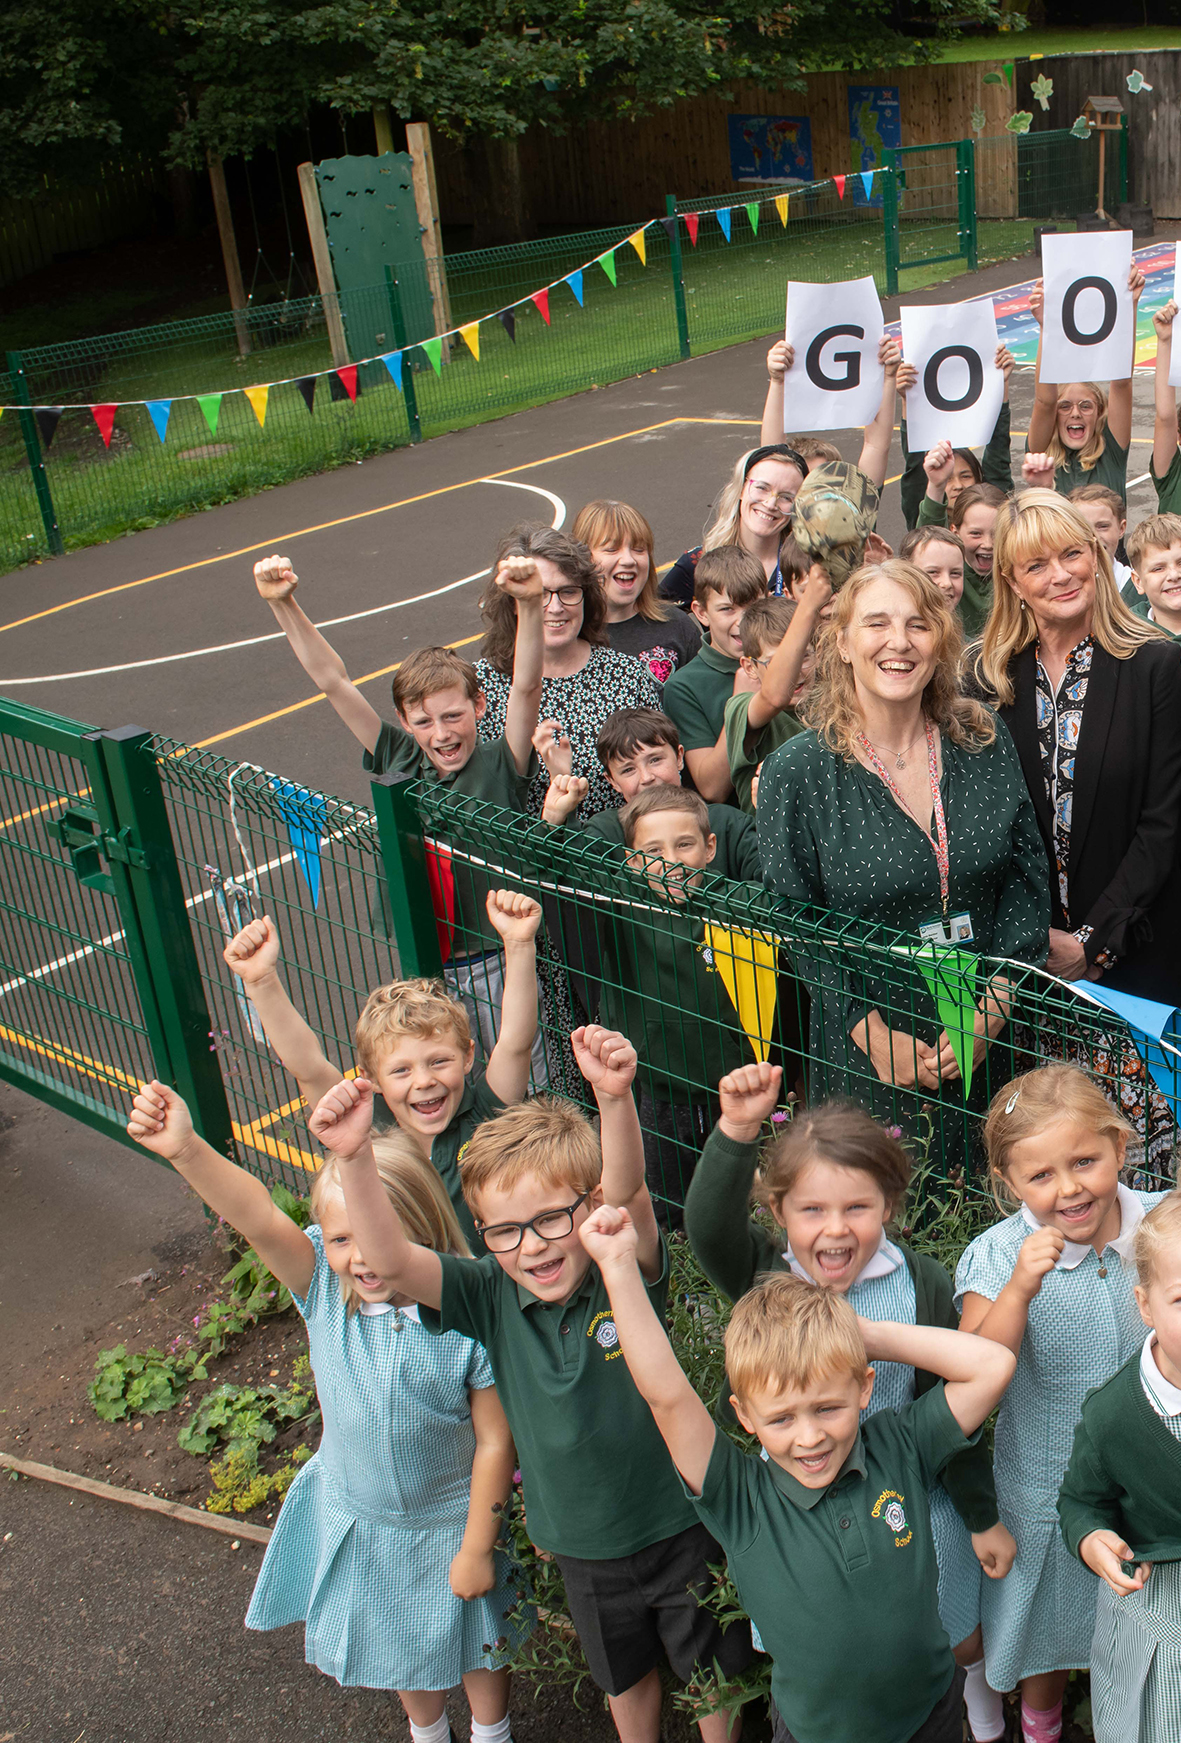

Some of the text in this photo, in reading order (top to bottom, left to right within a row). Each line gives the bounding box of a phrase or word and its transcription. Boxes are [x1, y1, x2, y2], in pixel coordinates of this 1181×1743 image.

[1061, 275, 1117, 346] O
[923, 344, 984, 412] O
[604, 1347, 624, 1361] Scho
